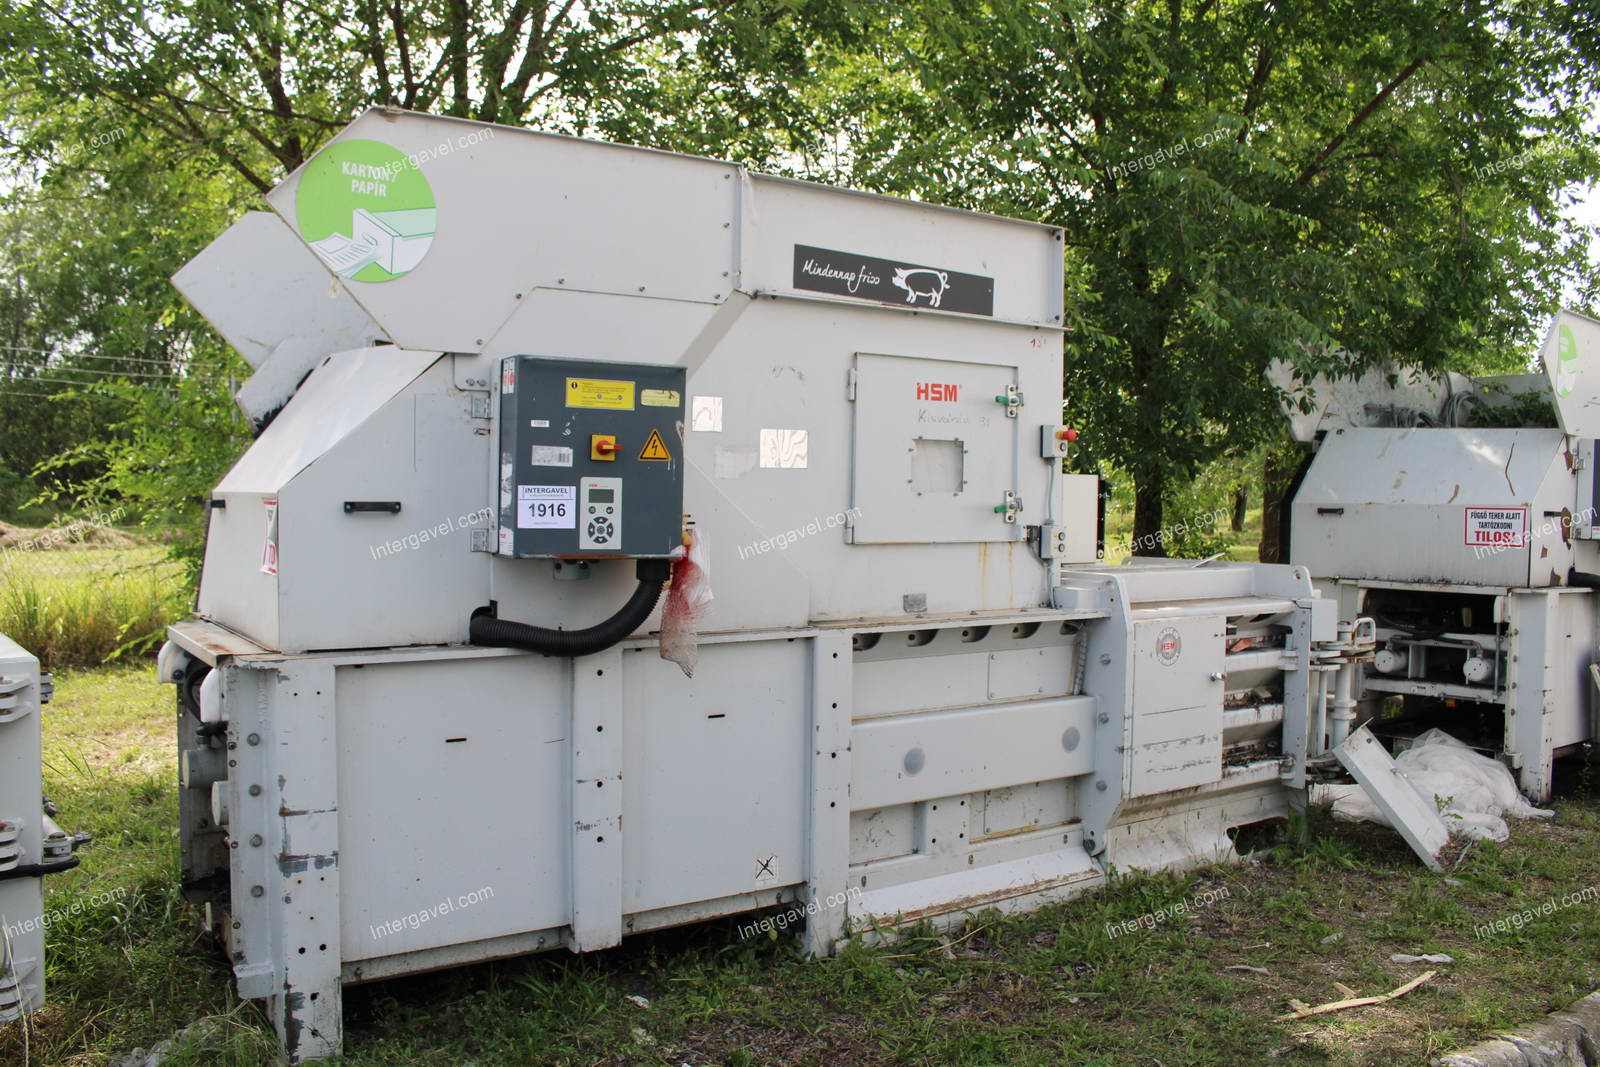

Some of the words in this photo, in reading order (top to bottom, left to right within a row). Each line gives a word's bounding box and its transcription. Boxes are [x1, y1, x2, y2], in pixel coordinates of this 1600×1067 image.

[351, 179, 386, 197] PAPÍR
[916, 383, 958, 402] HSM
[529, 503, 566, 517] 1916
[1488, 512, 1504, 520] TEHER
[1505, 512, 1521, 520] ALATT
[1478, 521, 1513, 530] TARTÓZKODNI
[1475, 530, 1516, 543] TILOS!
